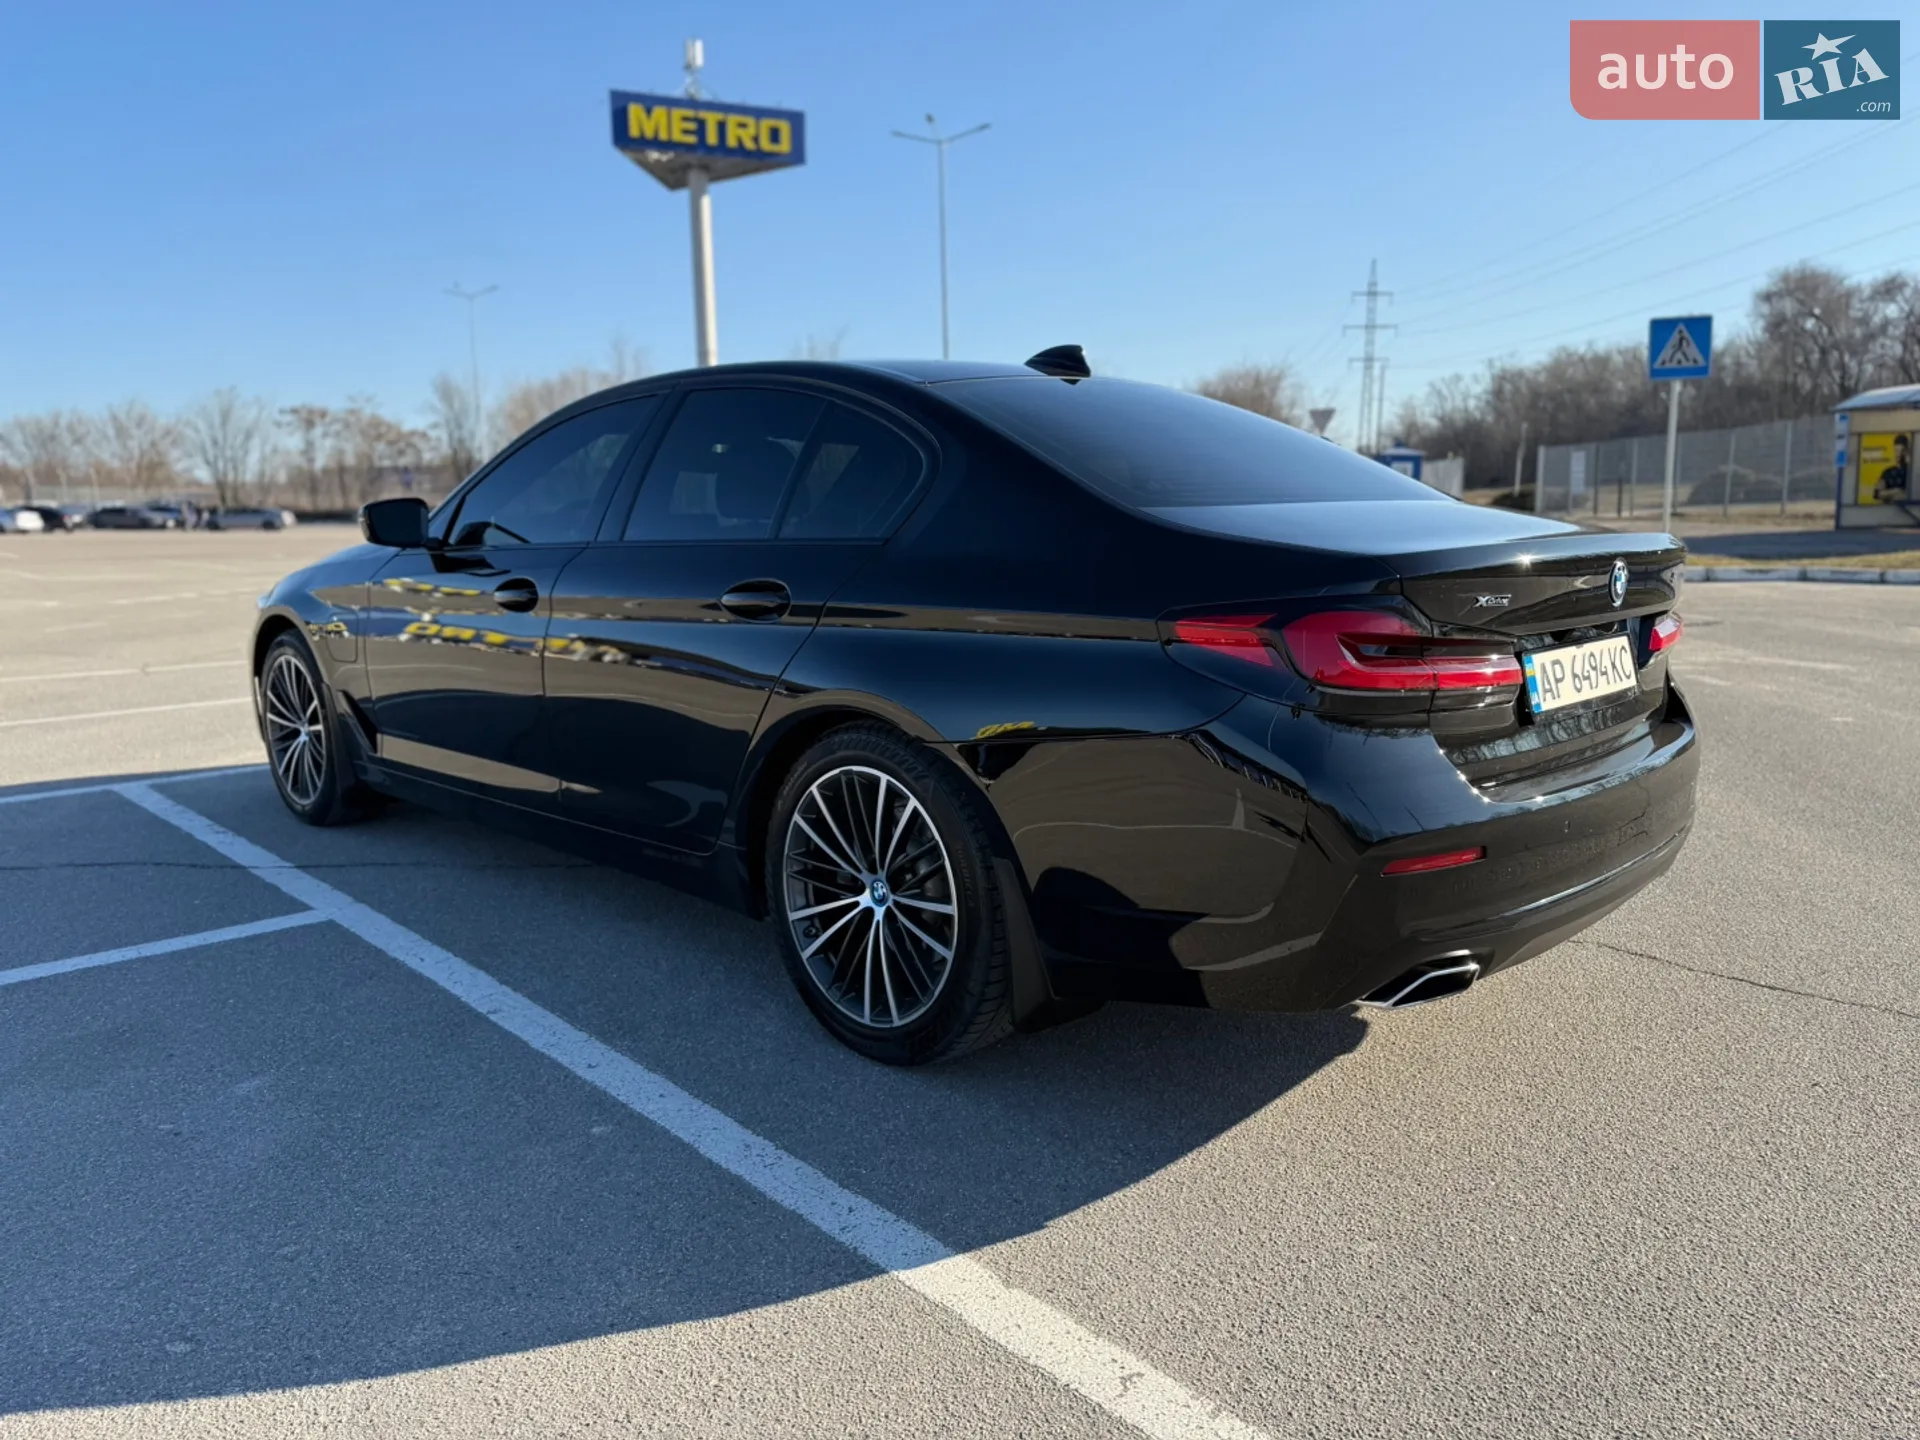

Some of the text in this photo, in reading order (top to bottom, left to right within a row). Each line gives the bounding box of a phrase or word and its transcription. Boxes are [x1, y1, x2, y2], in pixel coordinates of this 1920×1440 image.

[627, 102, 792, 154] METRO
[1540, 645, 1632, 702] AP 6494 KC
